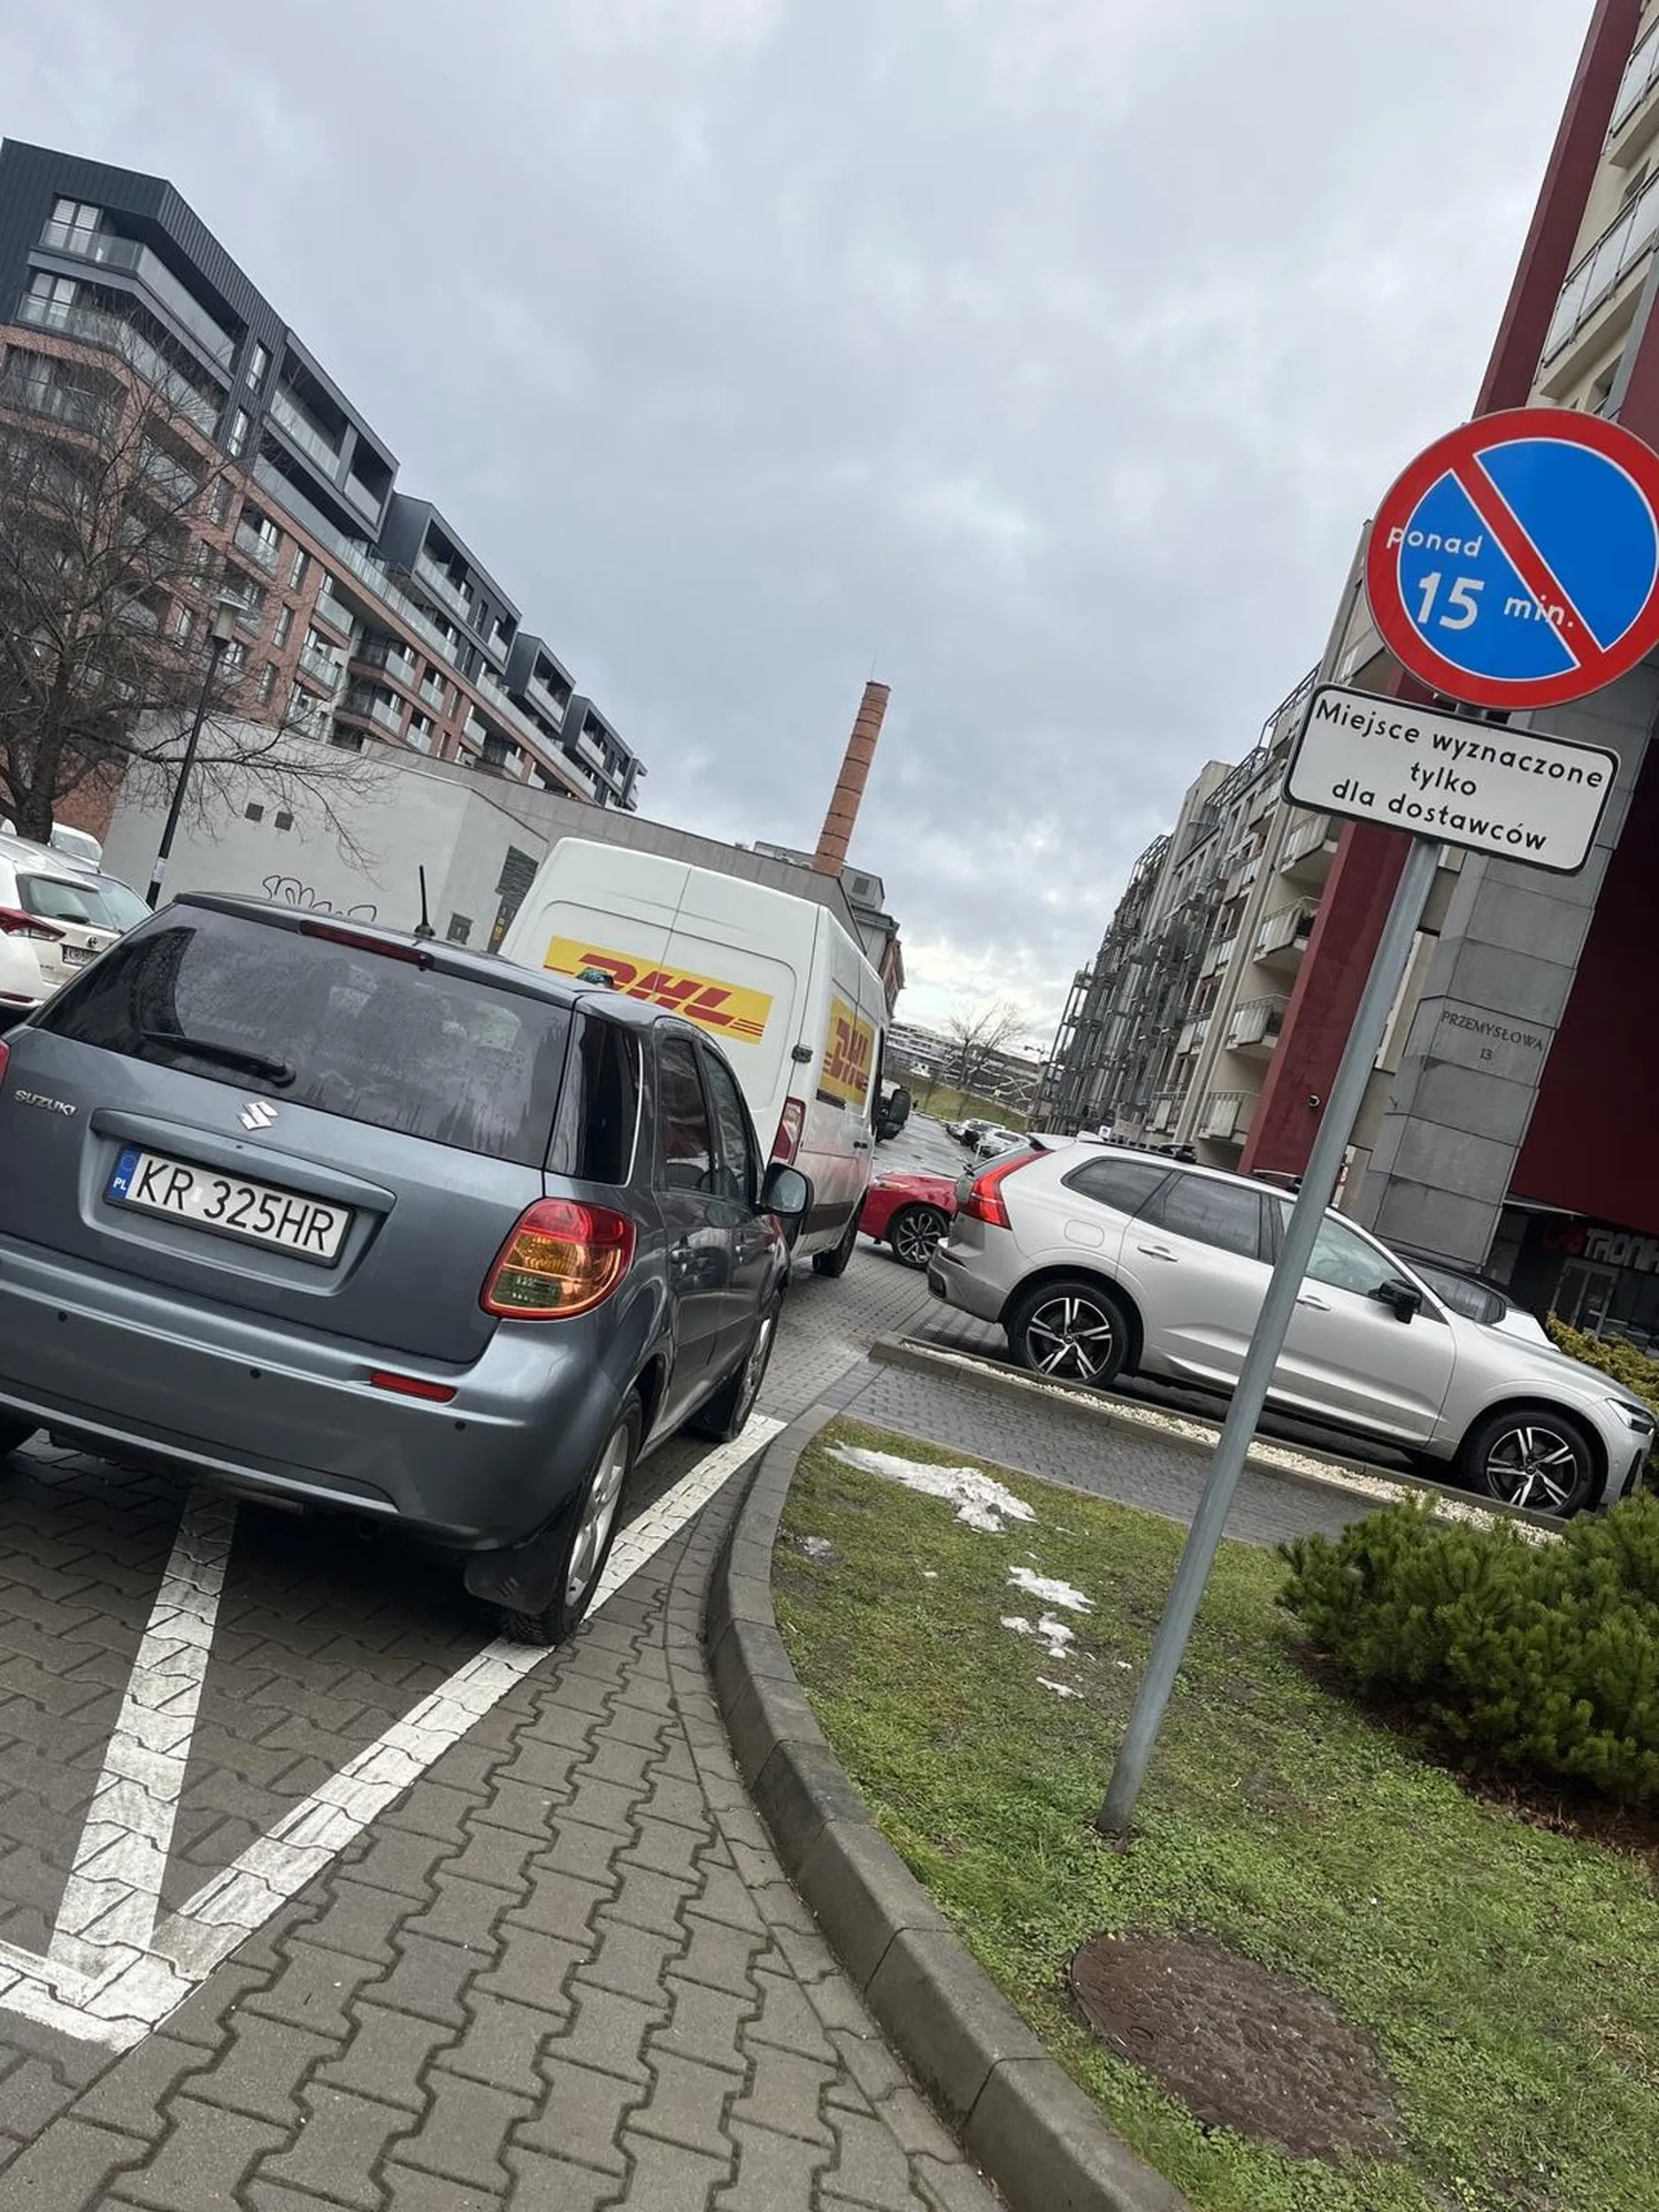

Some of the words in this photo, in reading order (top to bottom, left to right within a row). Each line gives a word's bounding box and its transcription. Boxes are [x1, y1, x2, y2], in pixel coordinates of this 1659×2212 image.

[1386, 526, 1483, 557] ponad
[1417, 572, 1485, 630] 15
[1504, 594, 1574, 628] min.
[1316, 699, 1420, 743] Miejsce
[1432, 732, 1603, 788] wyznaczone
[1409, 761, 1478, 796] tylko
[1332, 779, 1375, 807] dla
[1387, 793, 1548, 850] dostawców
[578, 953, 736, 1026] DHL
[1441, 1010, 1542, 1051] PRZEMYSŁOWA
[1480, 1048, 1493, 1061] 13
[14, 1089, 77, 1117] SUZUKI
[112, 1177, 127, 1191] PL
[136, 1160, 194, 1210] KR
[204, 1180, 334, 1251] 325HR
